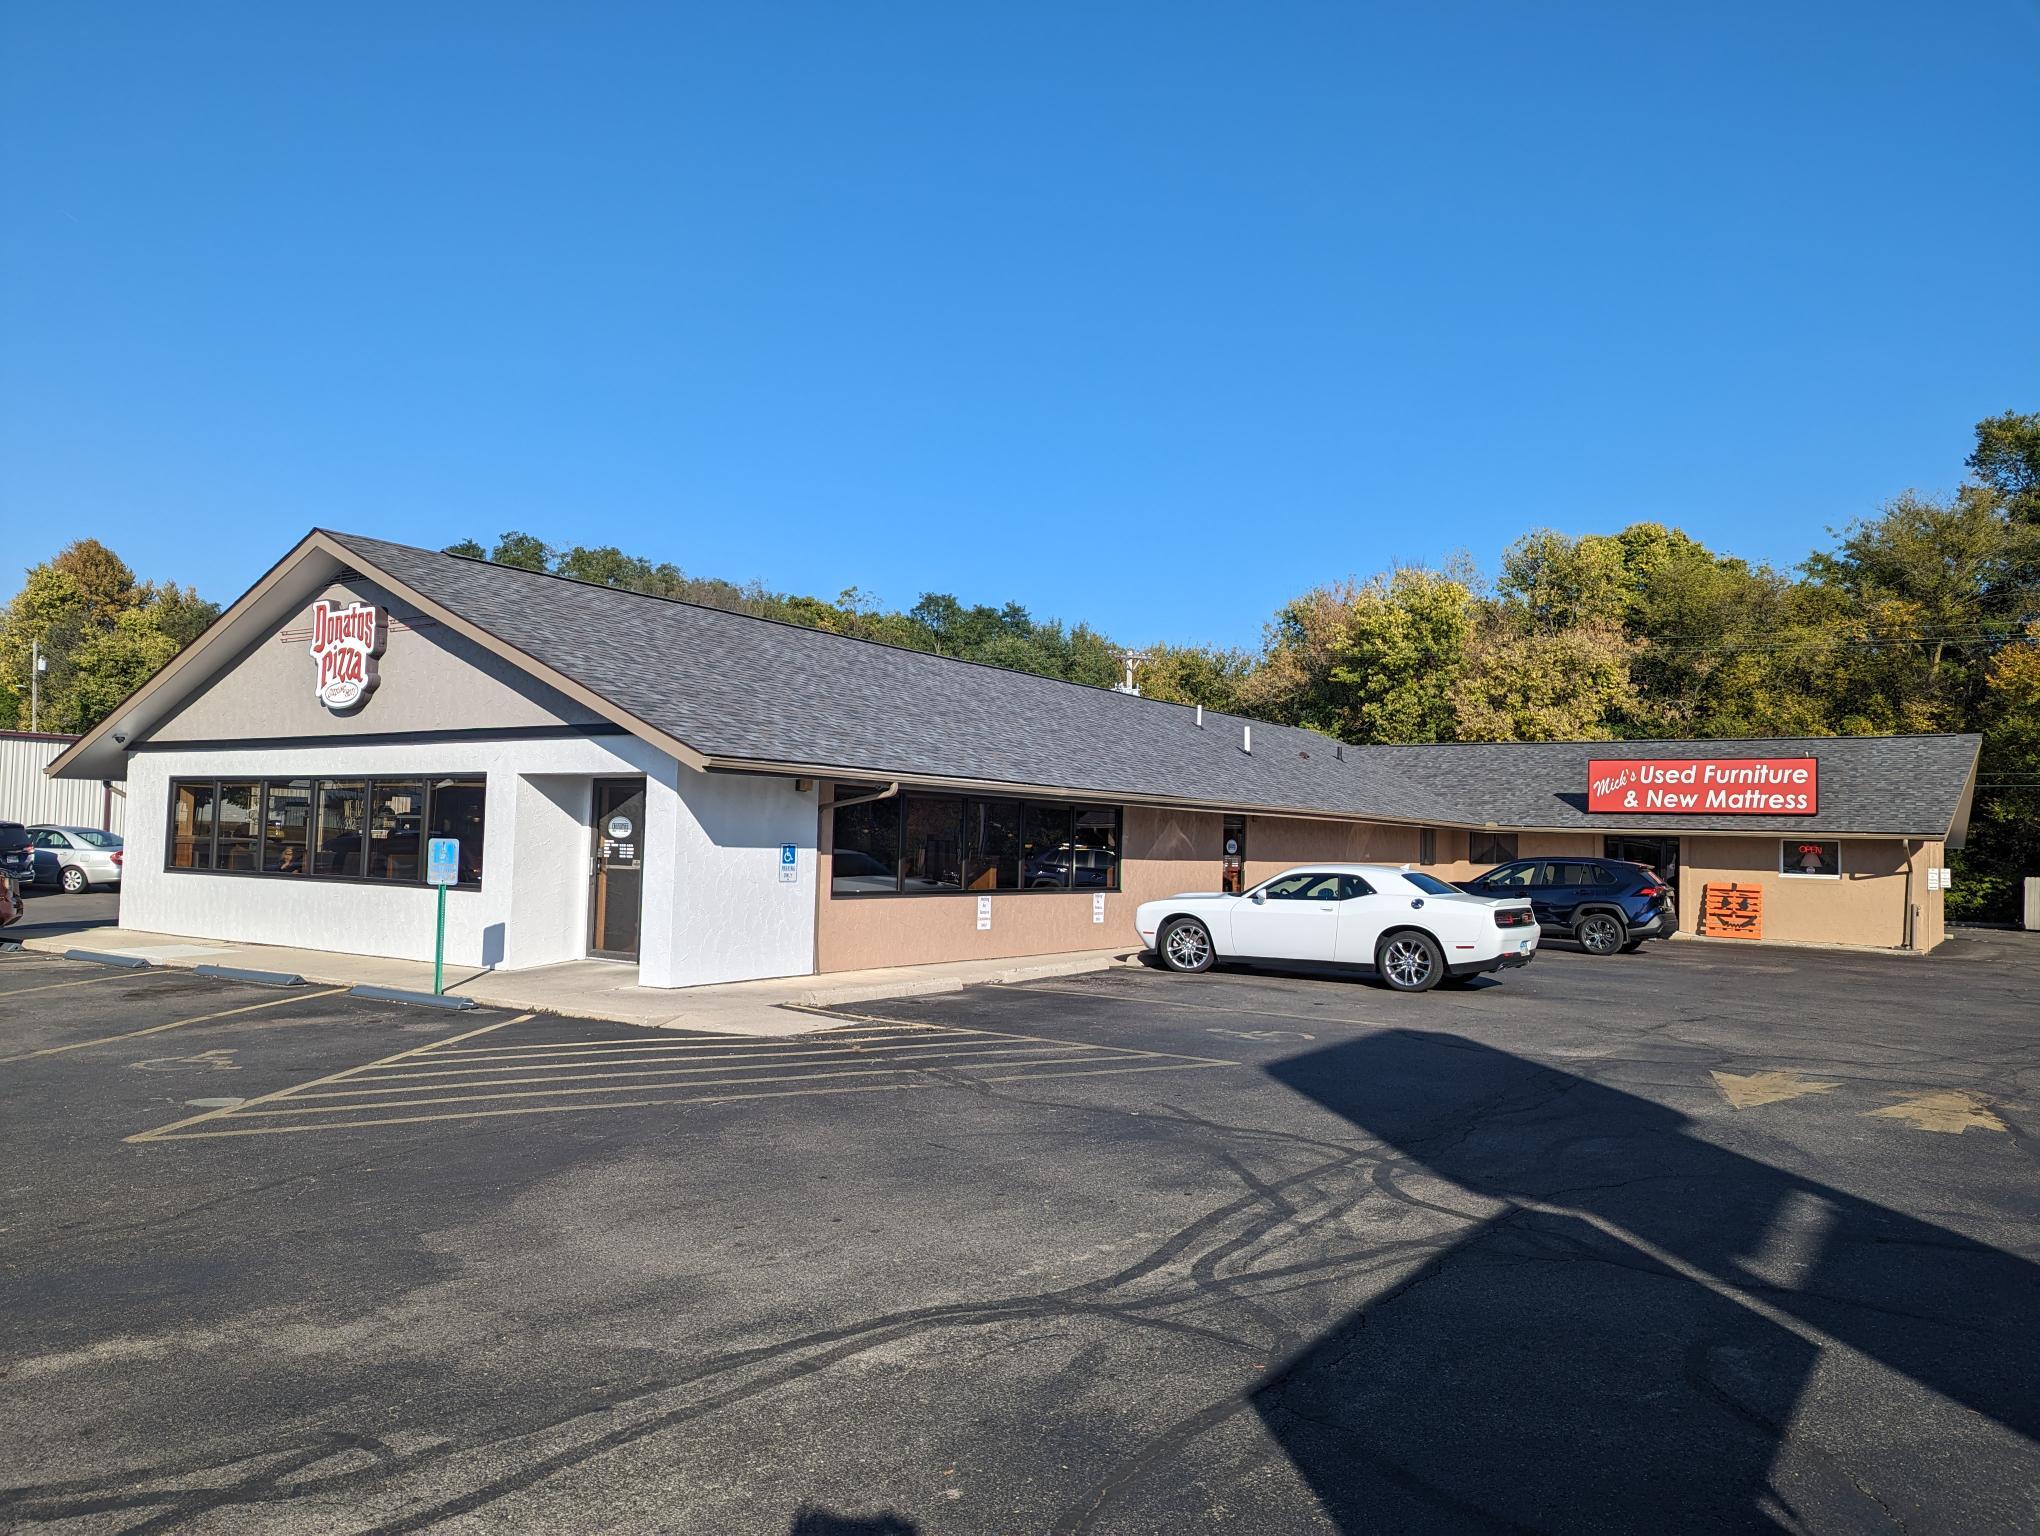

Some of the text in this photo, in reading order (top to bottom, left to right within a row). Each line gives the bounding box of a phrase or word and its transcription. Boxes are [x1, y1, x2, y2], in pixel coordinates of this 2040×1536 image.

[313, 605, 374, 653] Donatos
[1593, 765, 1809, 797] Mick's Used Furniture
[1623, 790, 1808, 809] & New Mattress
[1799, 845, 1823, 855] OPEN
